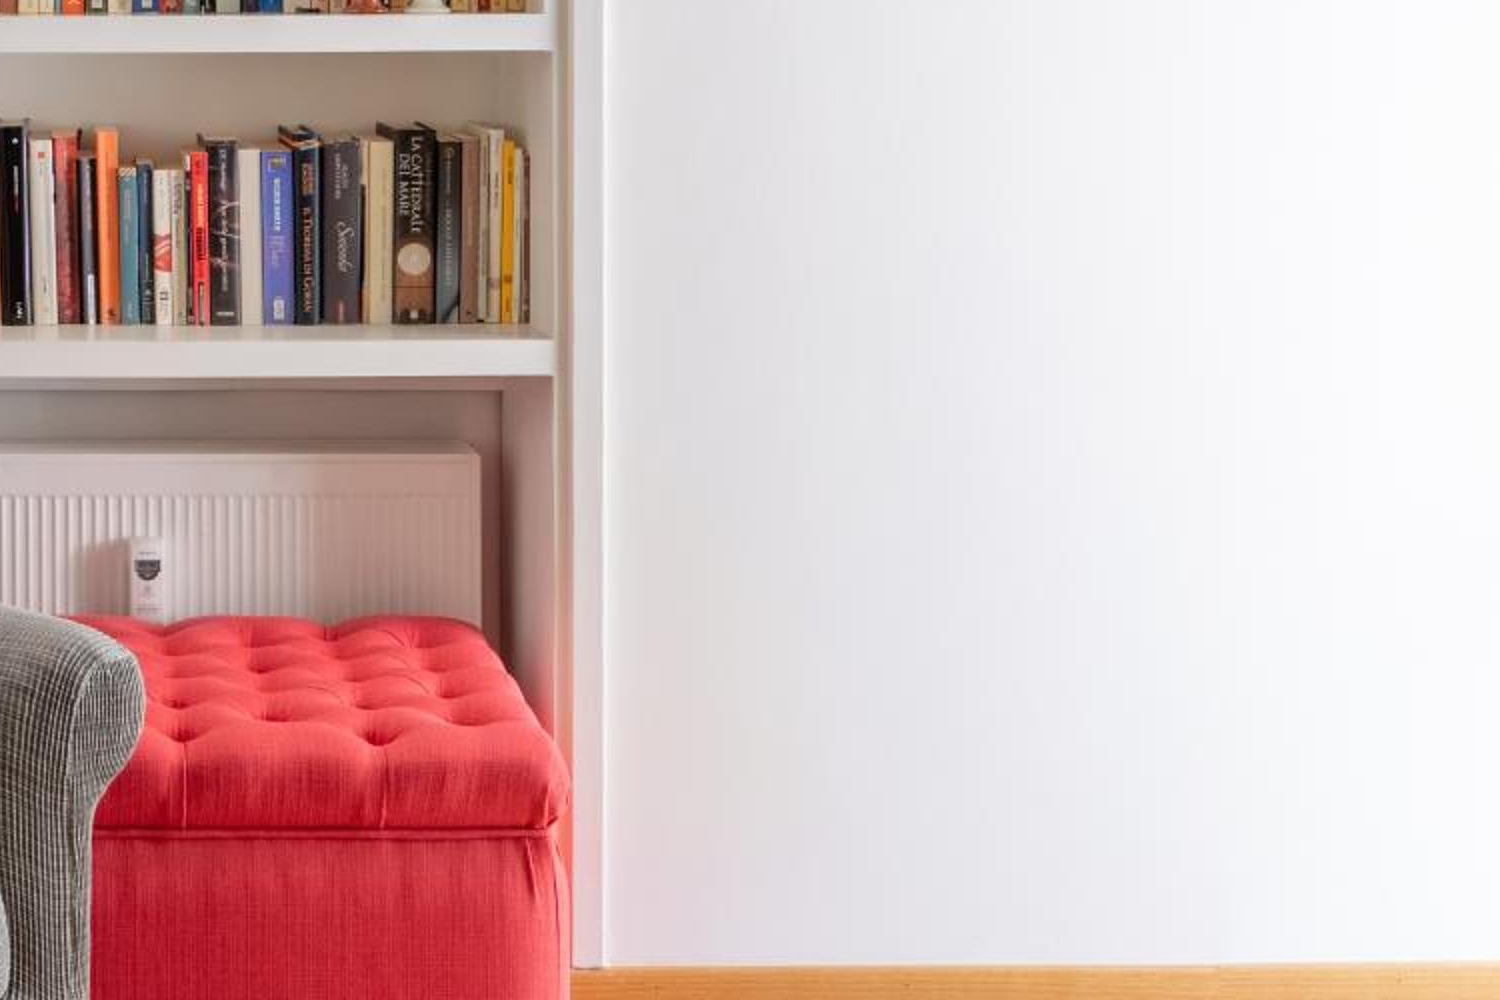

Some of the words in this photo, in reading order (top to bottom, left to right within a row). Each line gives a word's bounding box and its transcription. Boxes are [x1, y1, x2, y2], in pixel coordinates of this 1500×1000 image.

[411, 135, 425, 150] LA
[398, 152, 411, 175] DEL
[398, 180, 411, 217] MARE
[411, 153, 425, 233] CATTEDRALE
